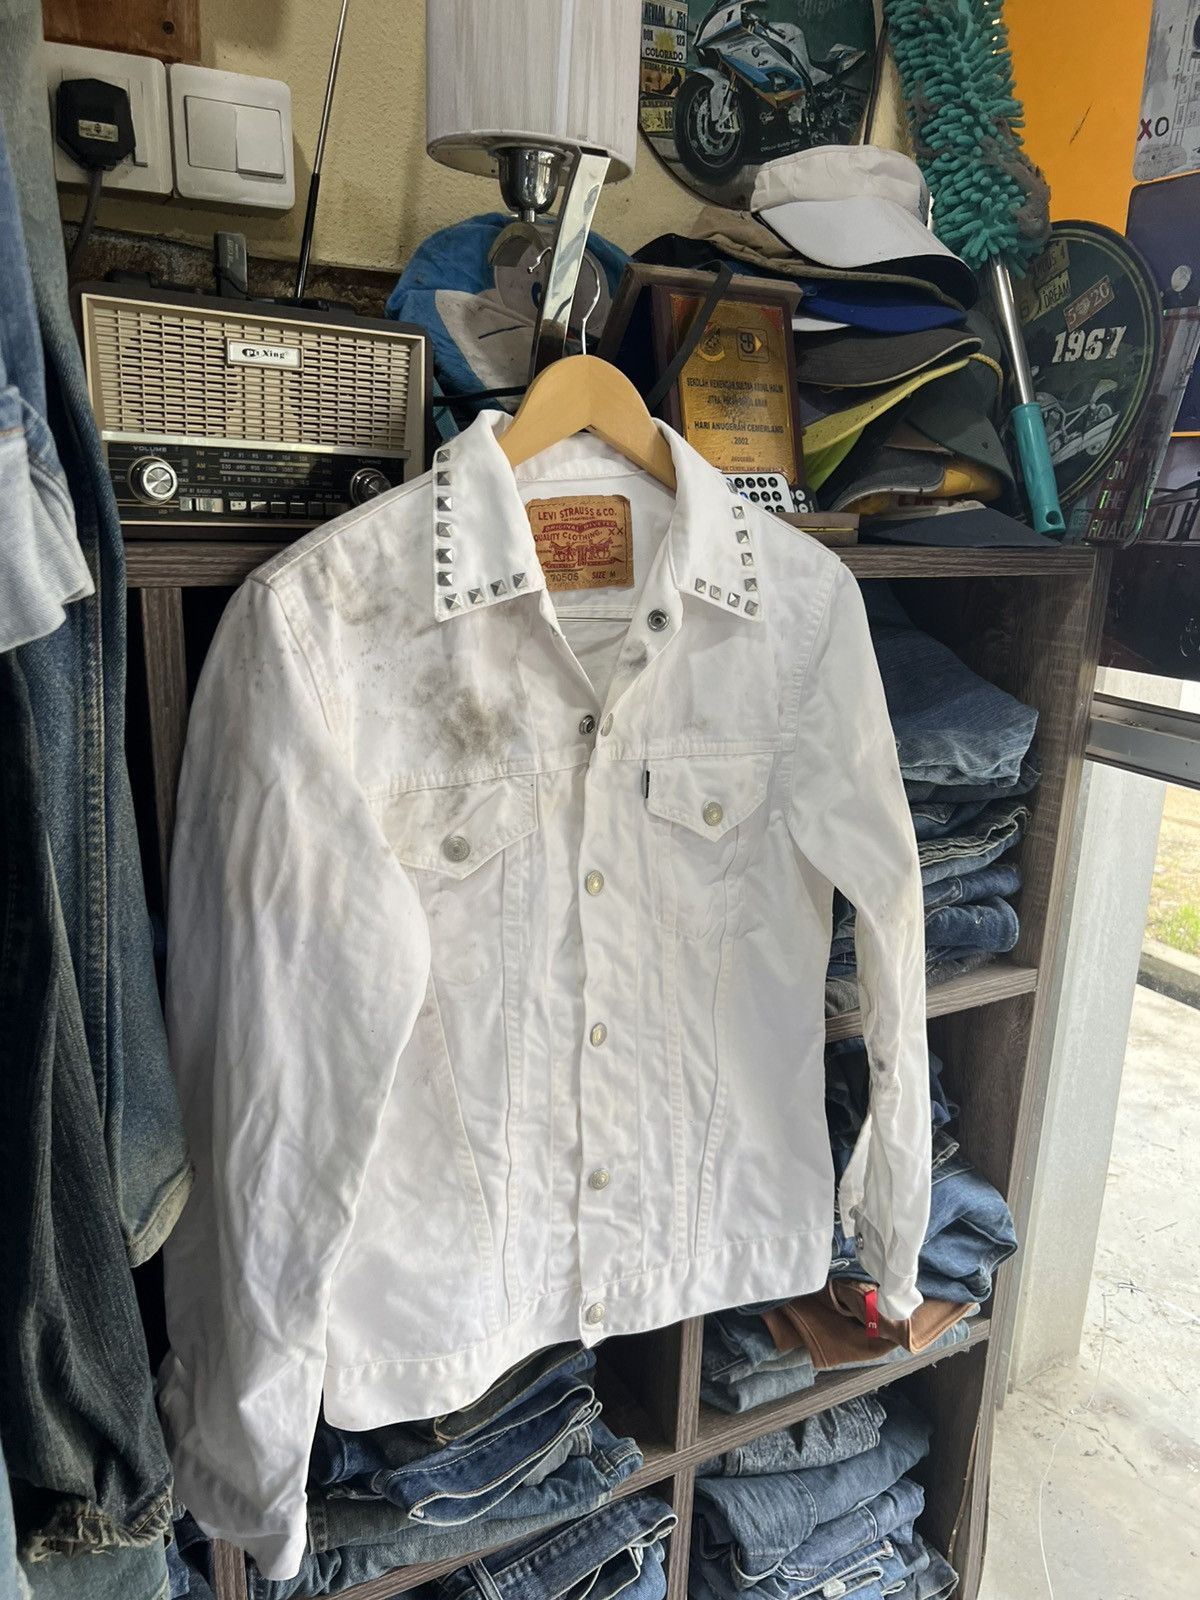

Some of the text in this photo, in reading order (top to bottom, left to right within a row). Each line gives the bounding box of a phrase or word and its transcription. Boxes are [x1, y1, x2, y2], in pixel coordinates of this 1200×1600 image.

[644, 47, 684, 61] COLORADO
[1052, 326, 1127, 364] 1967
[694, 421, 784, 434] HARI ANUGERAH CEMERLANG
[538, 511, 557, 521] LEVI
[560, 506, 594, 518] STRAUSS
[596, 509, 602, 517] &
[603, 507, 617, 517] CO.
[534, 532, 560, 543] QUALITY
[591, 570, 606, 580] SIZE
